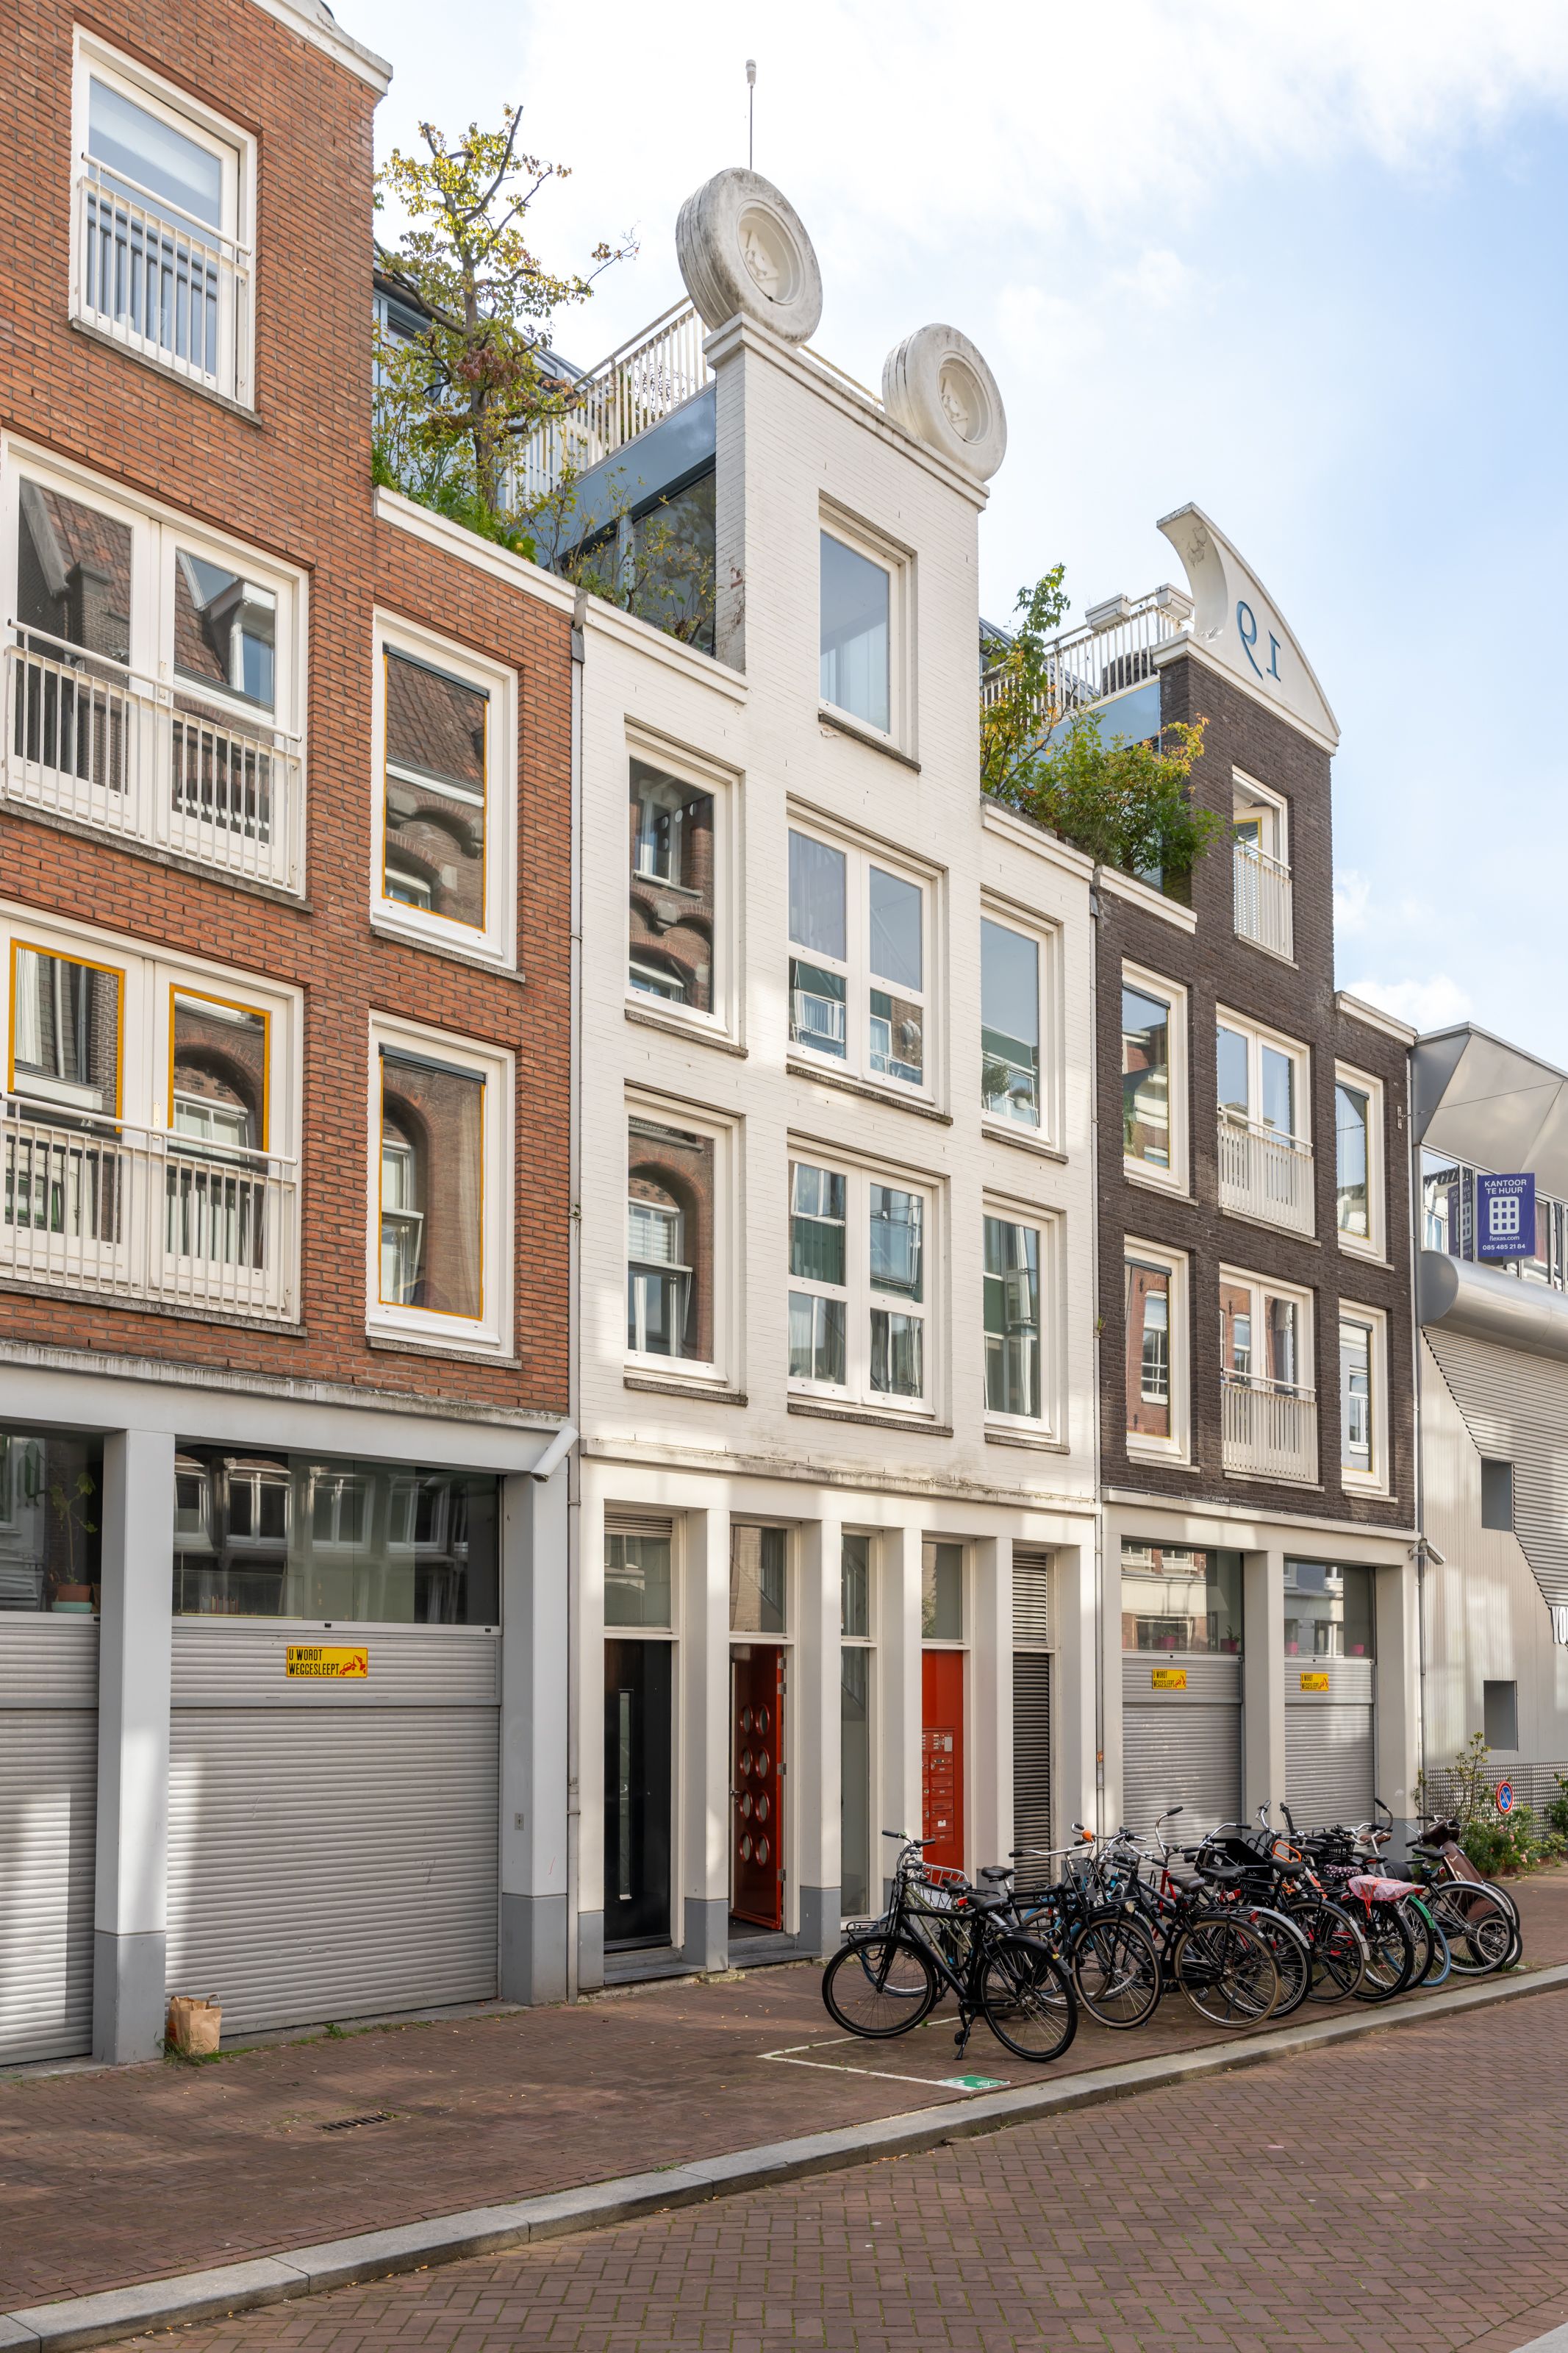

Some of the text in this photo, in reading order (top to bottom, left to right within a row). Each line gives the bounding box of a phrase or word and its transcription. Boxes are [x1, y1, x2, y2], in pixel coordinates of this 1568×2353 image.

[1484, 1179, 1527, 1188] KANTOOR
[1498, 1186, 1523, 1194] HUUR
[1550, 1607, 1568, 1644] YO
[289, 1649, 323, 1661] U WORDT
[289, 1663, 340, 1675] WEGGESLEEPT
